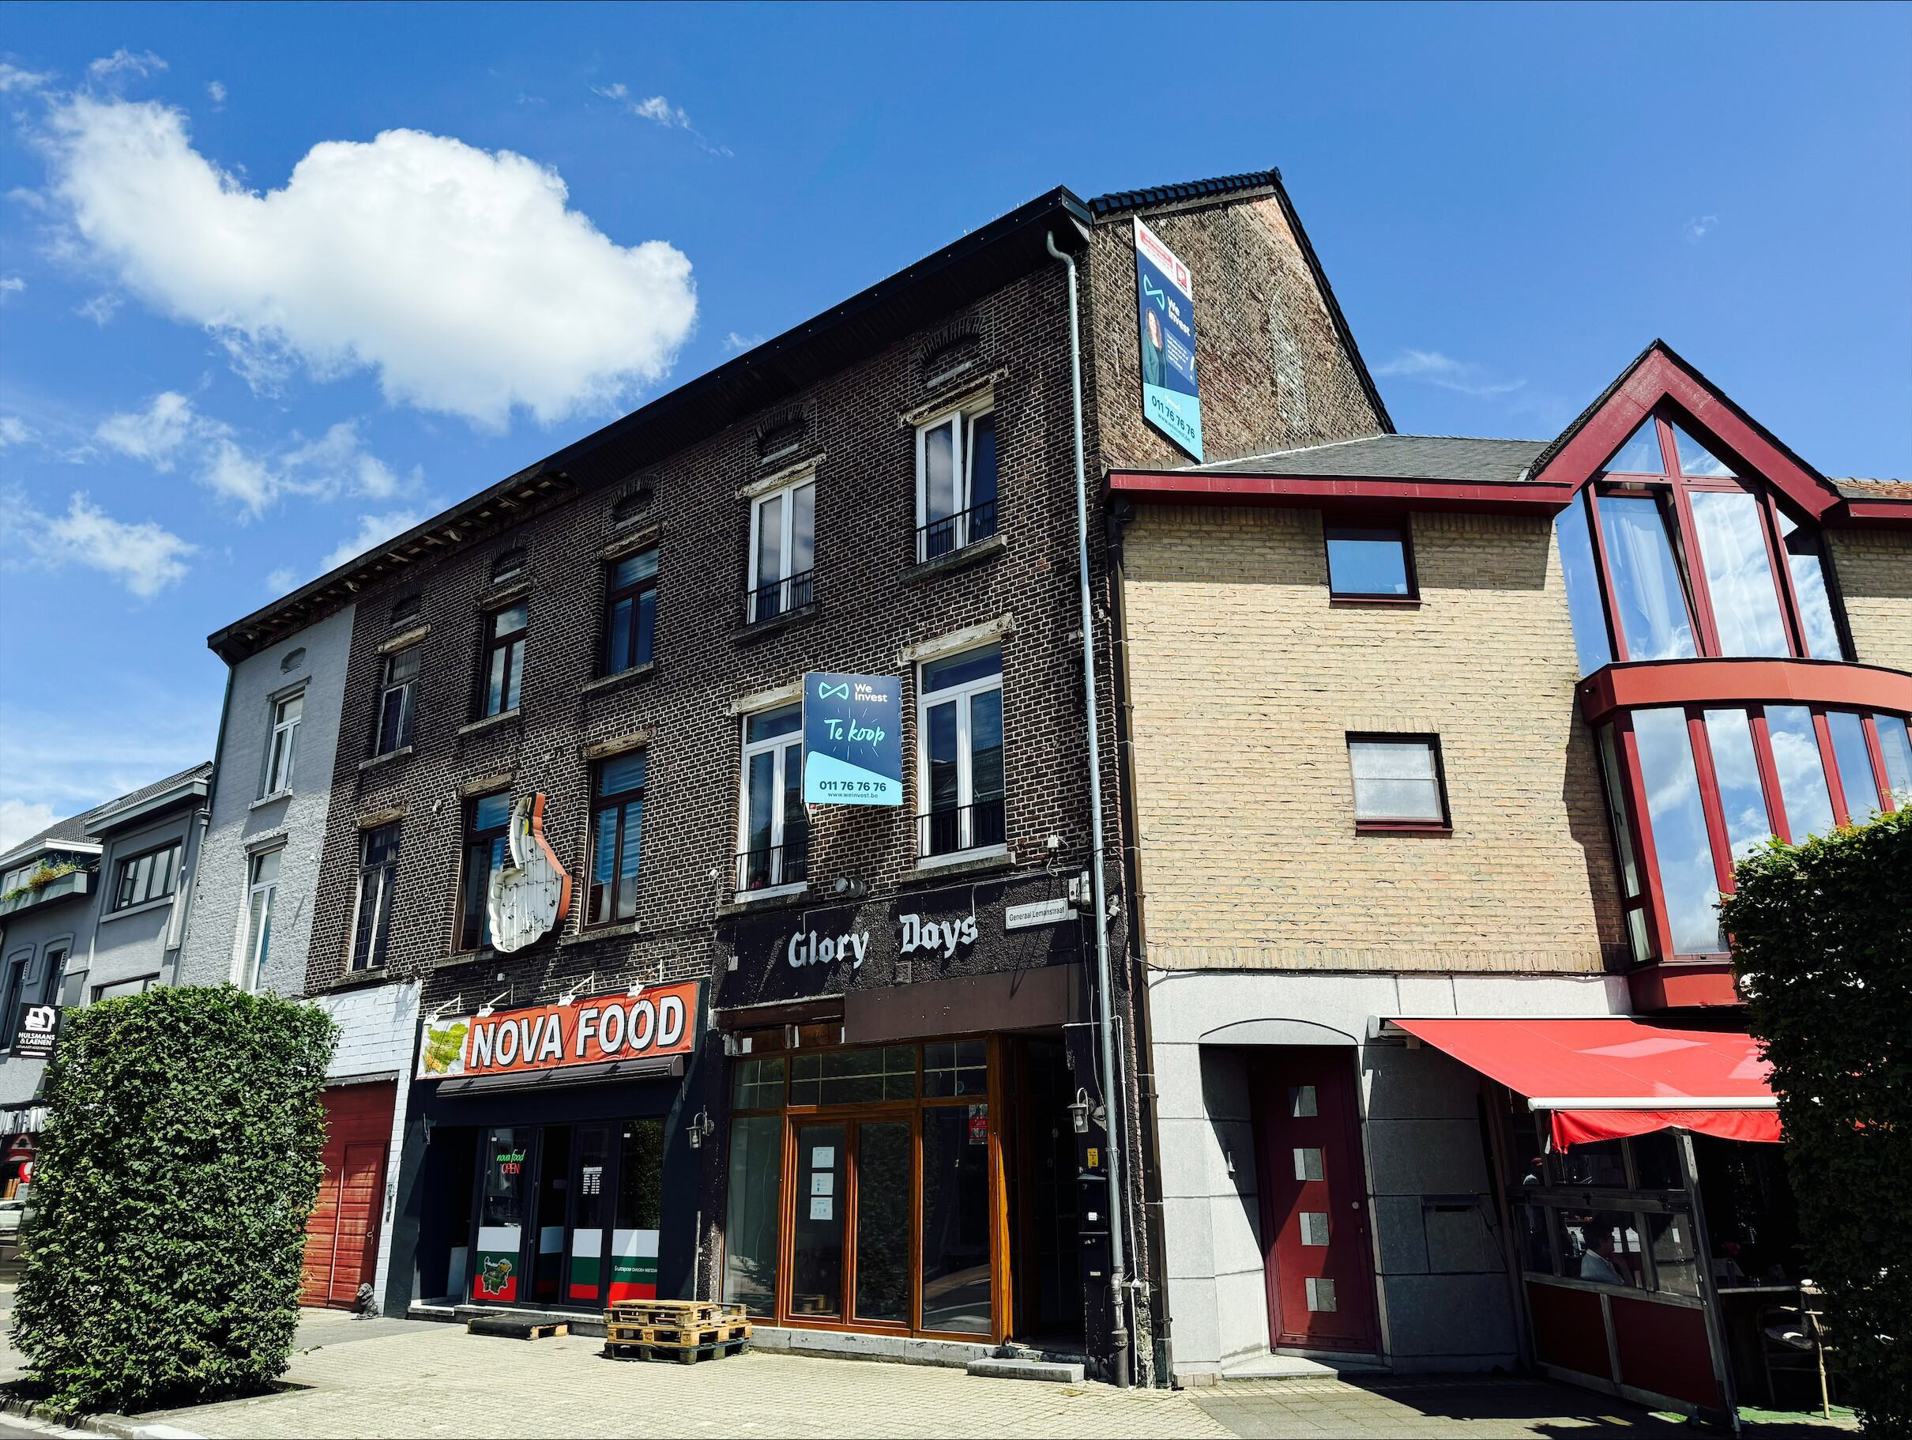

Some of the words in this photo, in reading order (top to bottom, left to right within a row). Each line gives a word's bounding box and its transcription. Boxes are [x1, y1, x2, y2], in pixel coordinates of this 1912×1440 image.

[1152, 395, 1164, 413] 011
[1165, 406, 1175, 422] 76
[1176, 415, 1185, 430] 76
[1186, 424, 1195, 439] 76
[854, 683, 873, 693] We
[854, 692, 888, 702] Invest
[824, 718, 843, 740] Te
[847, 718, 886, 747] koop
[819, 780, 838, 791] 011
[840, 780, 854, 791] 76
[857, 781, 871, 792] 76
[873, 782, 887, 792] 76
[788, 929, 870, 969] Glory
[899, 913, 979, 959] Days
[470, 1013, 563, 1068] NOVA
[575, 995, 685, 1057] FOOD
[510, 1149, 526, 1163] food
[501, 1163, 520, 1175] OPEN
